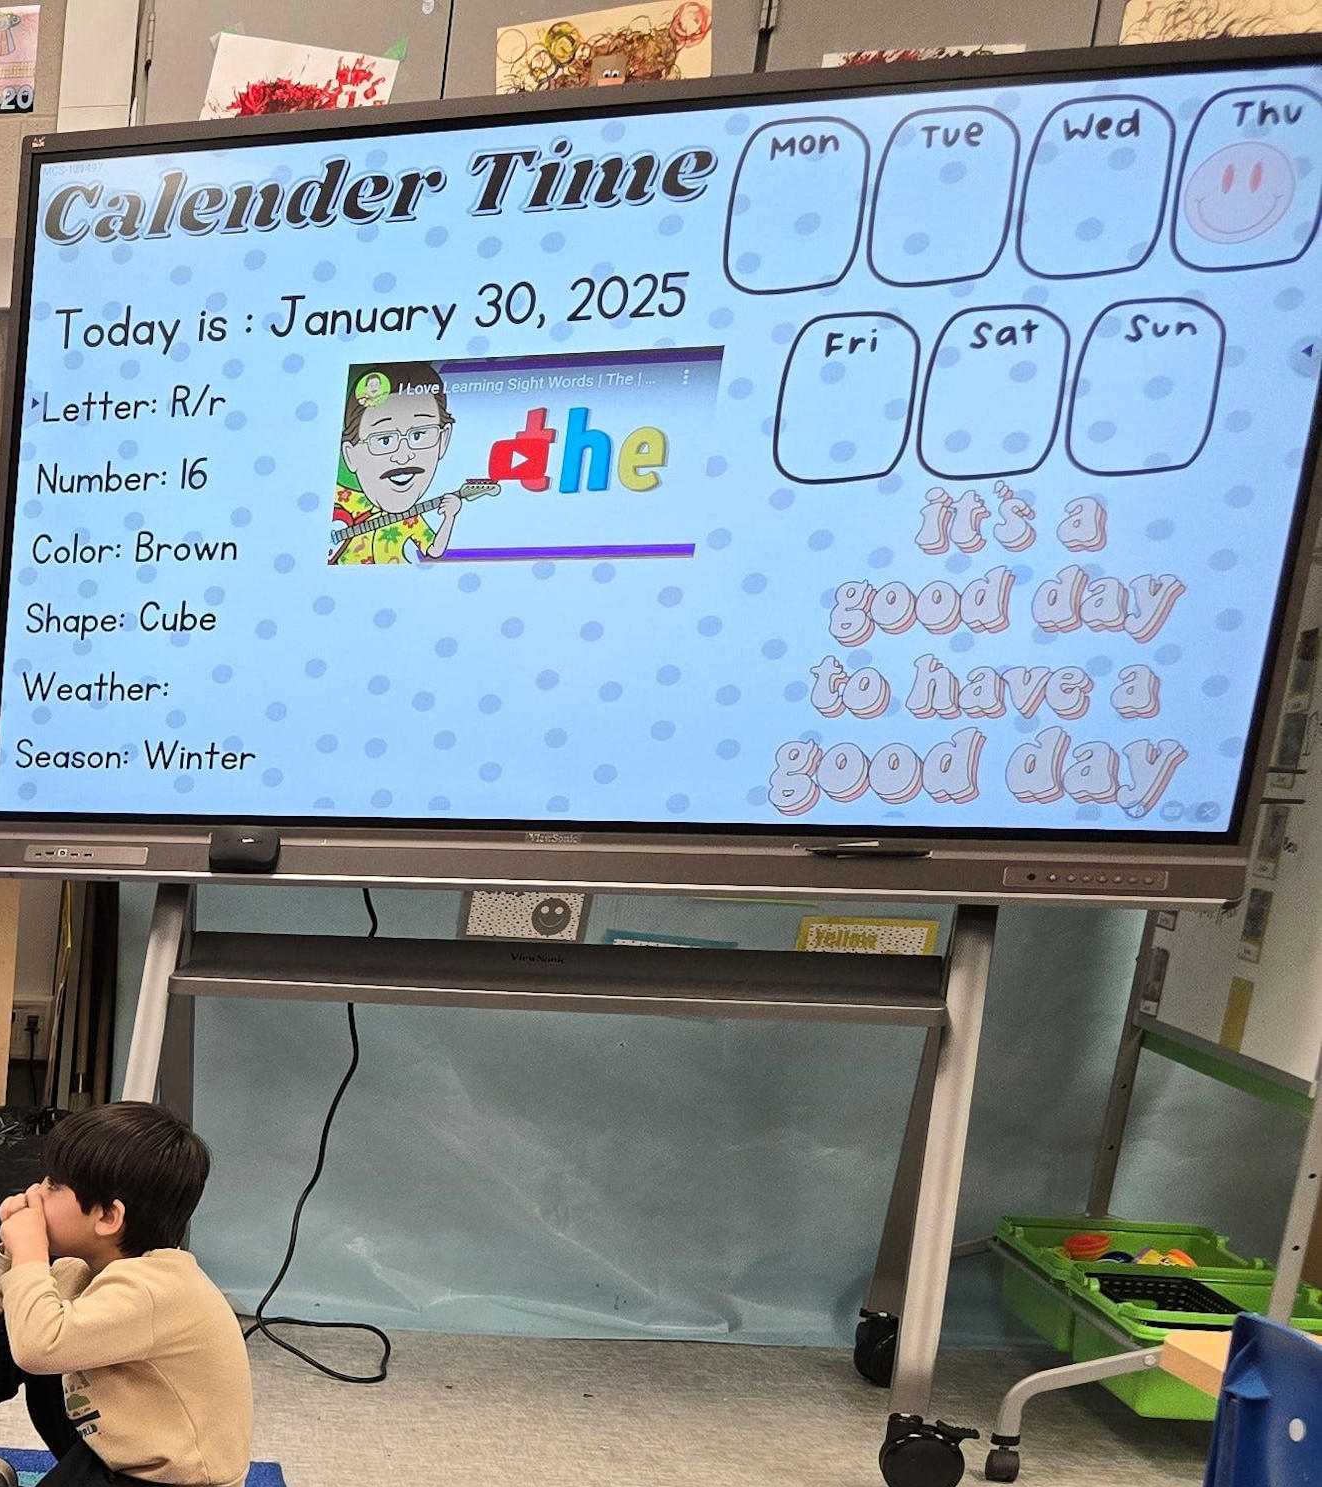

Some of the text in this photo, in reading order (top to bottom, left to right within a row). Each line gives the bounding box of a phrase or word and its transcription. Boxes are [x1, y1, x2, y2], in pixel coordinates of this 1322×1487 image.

[0, 84, 34, 110] 20
[1232, 99, 1304, 128] Thu
[921, 119, 984, 150] Tue
[1064, 107, 1141, 140] Wed
[770, 131, 840, 161] Mon
[42, 137, 719, 247] Calender Time
[56, 272, 690, 355] Today is January 30, 2025
[1124, 313, 1197, 342] Sun
[825, 328, 878, 358] Fri
[970, 317, 1040, 348] Sat
[406, 372, 633, 396] Love Learning Sight Words The
[42, 384, 226, 422] Letter: R/r
[515, 406, 668, 494] the
[37, 457, 208, 495] Number: 16
[915, 480, 1107, 555] it's a
[32, 530, 237, 565] Color: Brown
[26, 600, 217, 641] Shape: Cube
[828, 564, 1186, 647] good day
[22, 671, 169, 702] Weather:
[809, 653, 1160, 719] to have a
[15, 738, 256, 770] Season: Winter
[767, 725, 1188, 819] good day
